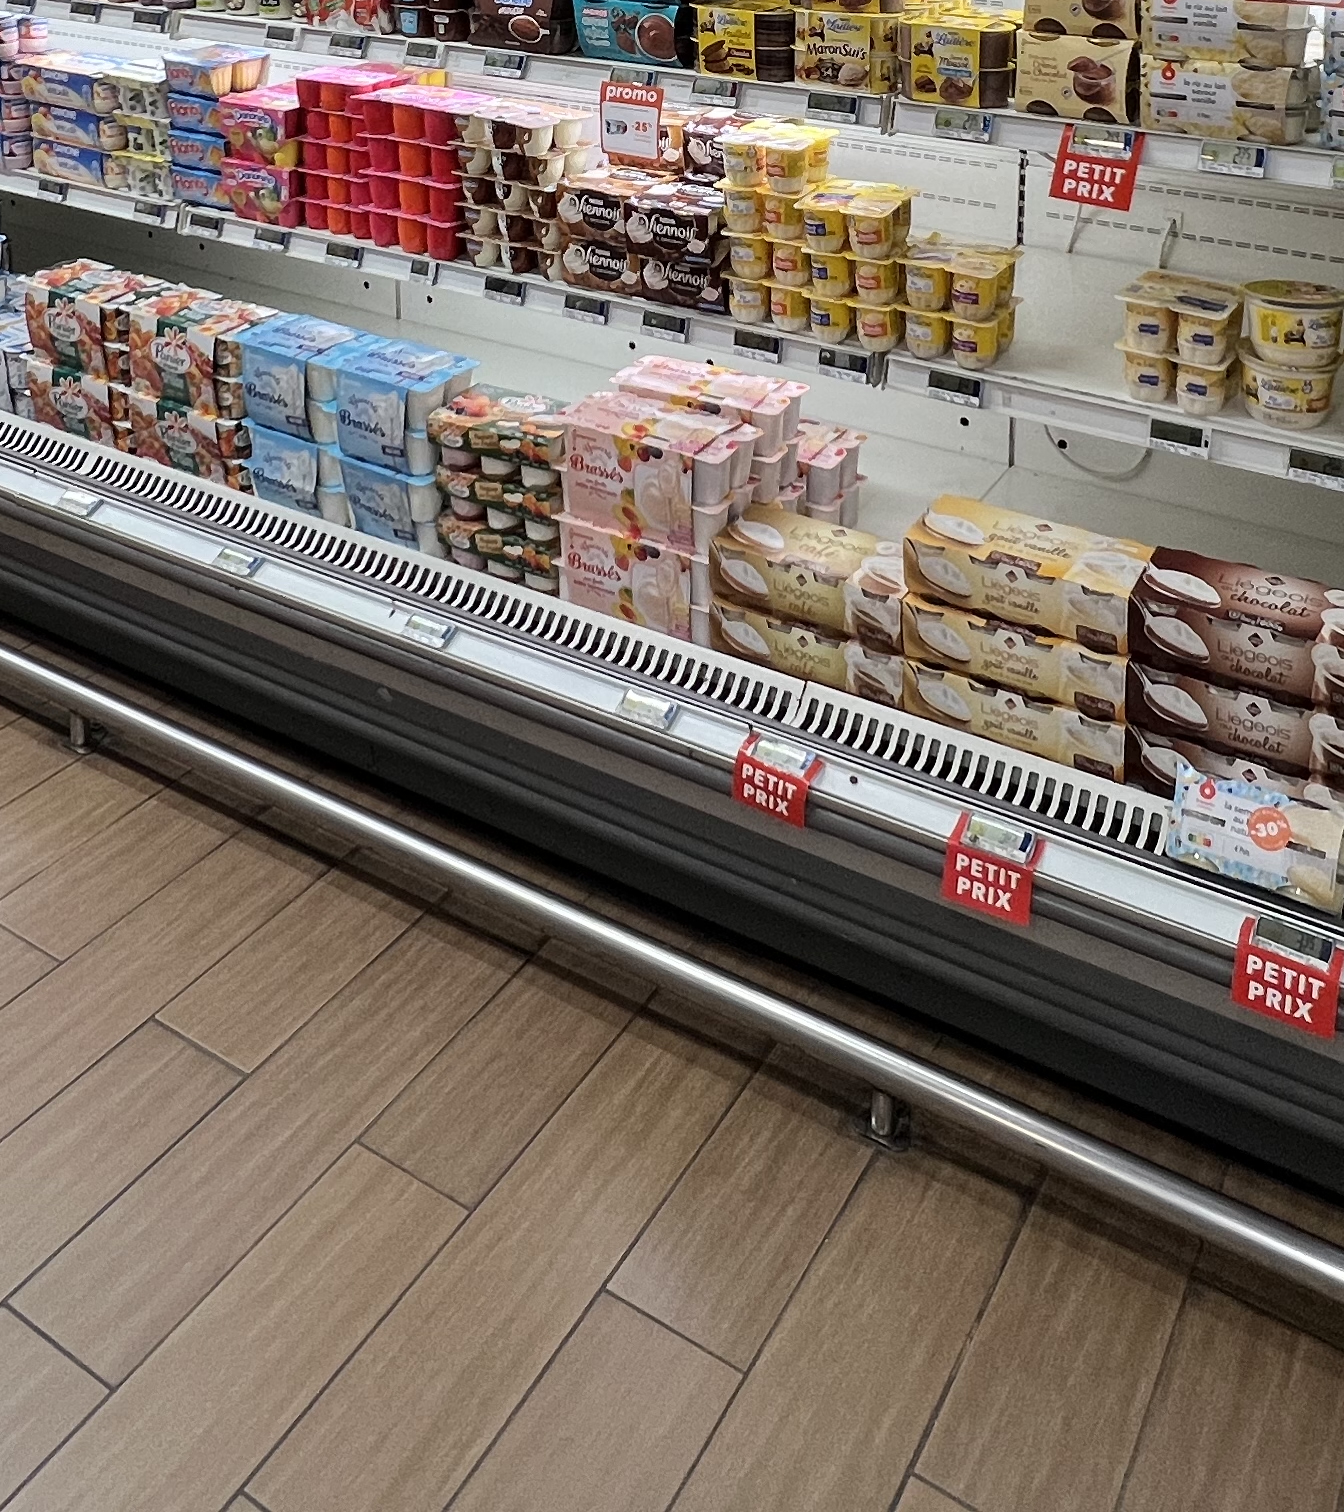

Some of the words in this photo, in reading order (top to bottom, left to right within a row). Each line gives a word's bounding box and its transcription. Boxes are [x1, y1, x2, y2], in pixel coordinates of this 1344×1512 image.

[806, 43, 867, 60] MaronSui's
[606, 86, 658, 103] promo
[1063, 159, 1126, 184] PETIT
[1063, 180, 1115, 202] PRIX
[572, 195, 622, 220] Viennois
[645, 214, 698, 242] Viennois
[580, 248, 630, 270] Viennois
[659, 264, 710, 286] Viennois
[339, 409, 386, 437] Brassés
[570, 456, 624, 483] Brassés
[568, 552, 622, 581] Brassés
[1219, 574, 1324, 608] Liégeois
[1231, 591, 1311, 618] chocolat
[1217, 641, 1292, 671] Liégeois
[1230, 662, 1287, 684] chocolat
[1215, 708, 1292, 738] Liégeois
[1228, 729, 1284, 754] chocolat
[742, 763, 797, 800] PETIT
[743, 783, 788, 816] PRIX
[956, 852, 1021, 889] PETIT
[957, 878, 1012, 912] PRIX
[1246, 955, 1325, 1000] PETIT
[1248, 980, 1313, 1023] PRIX
